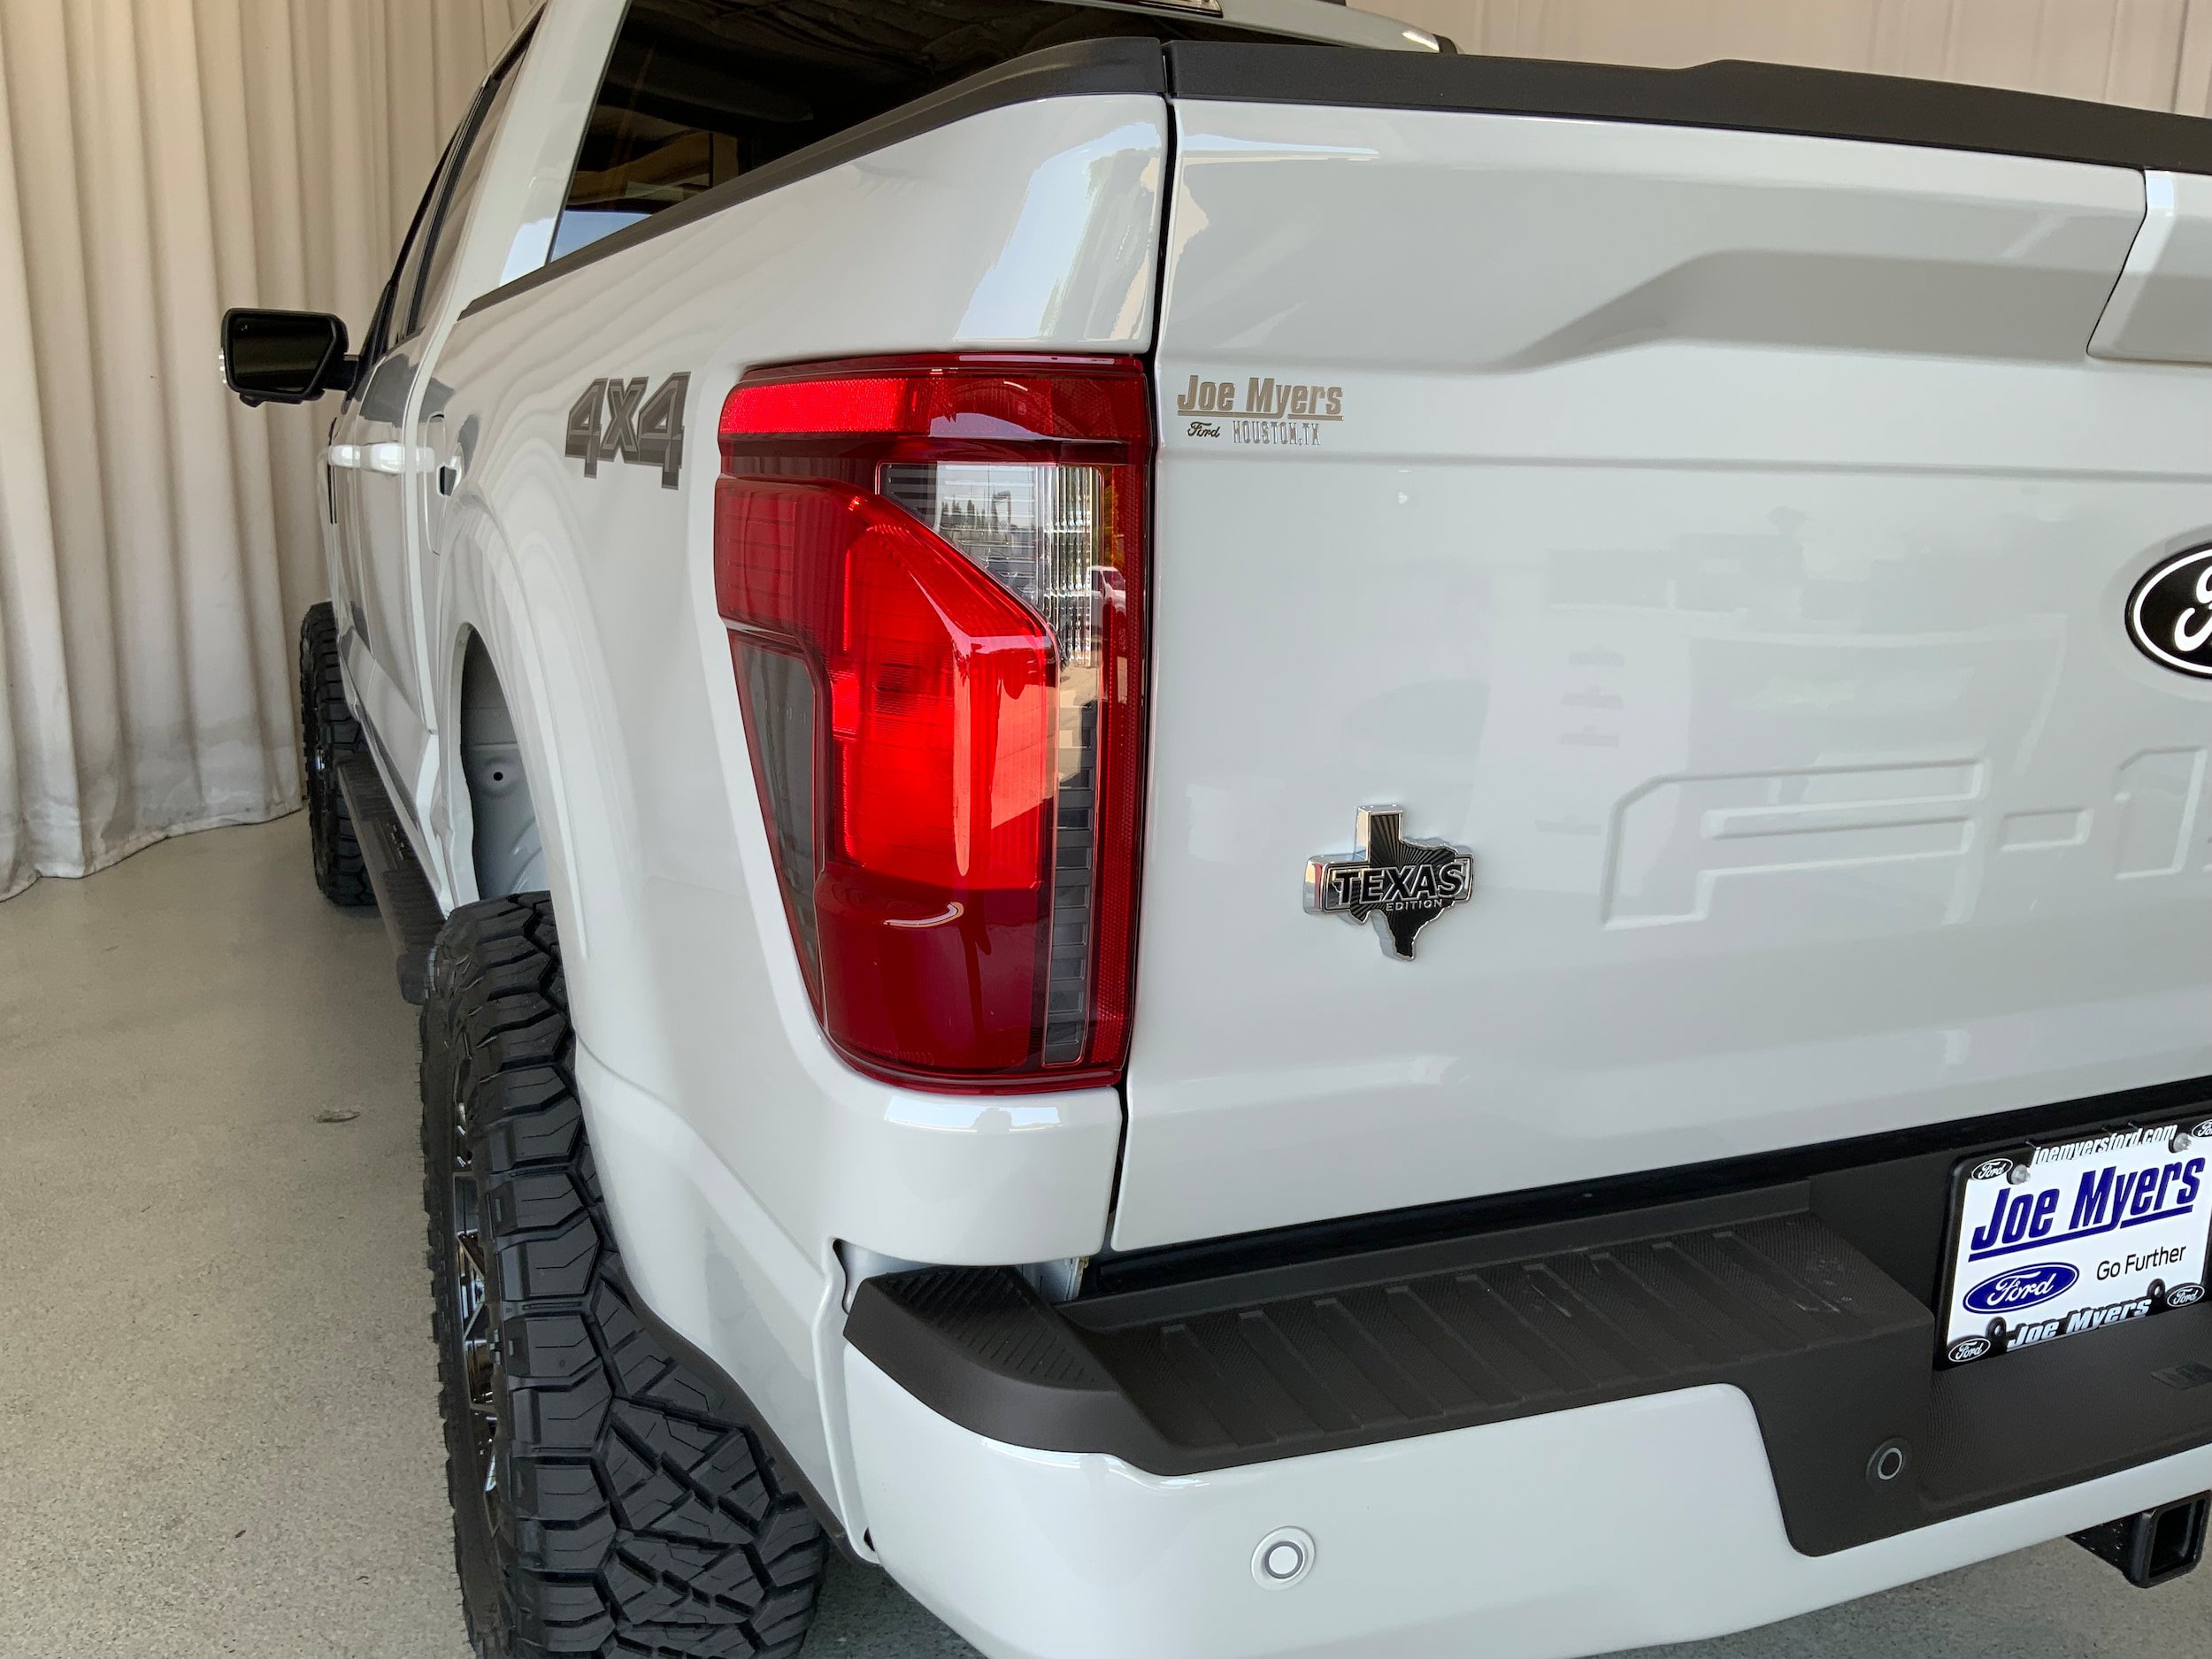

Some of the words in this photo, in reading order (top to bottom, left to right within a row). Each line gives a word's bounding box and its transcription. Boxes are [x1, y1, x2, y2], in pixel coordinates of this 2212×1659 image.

[1177, 374, 1236, 411] Joe
[1246, 377, 1344, 419] Myers
[1187, 421, 1221, 438] Ford
[1600, 746, 2212, 931] F-1
[1330, 863, 1465, 906] TEXAS
[1386, 898, 1443, 912] EDITION
[2035, 1124, 2177, 1165] joemyersford.com
[1978, 1163, 2006, 1179] Ford
[1970, 1187, 2060, 1251] Joe
[2069, 1157, 2206, 1232] Myers
[2096, 1260, 2121, 1281] Go
[2124, 1246, 2186, 1274] Further
[1986, 1271, 2058, 1306] Ford
[2173, 1288, 2199, 1304] Ford
[2007, 1323, 2060, 1348] Joe
[2065, 1298, 2153, 1333] Myers
[1955, 1341, 1983, 1359] Ford
